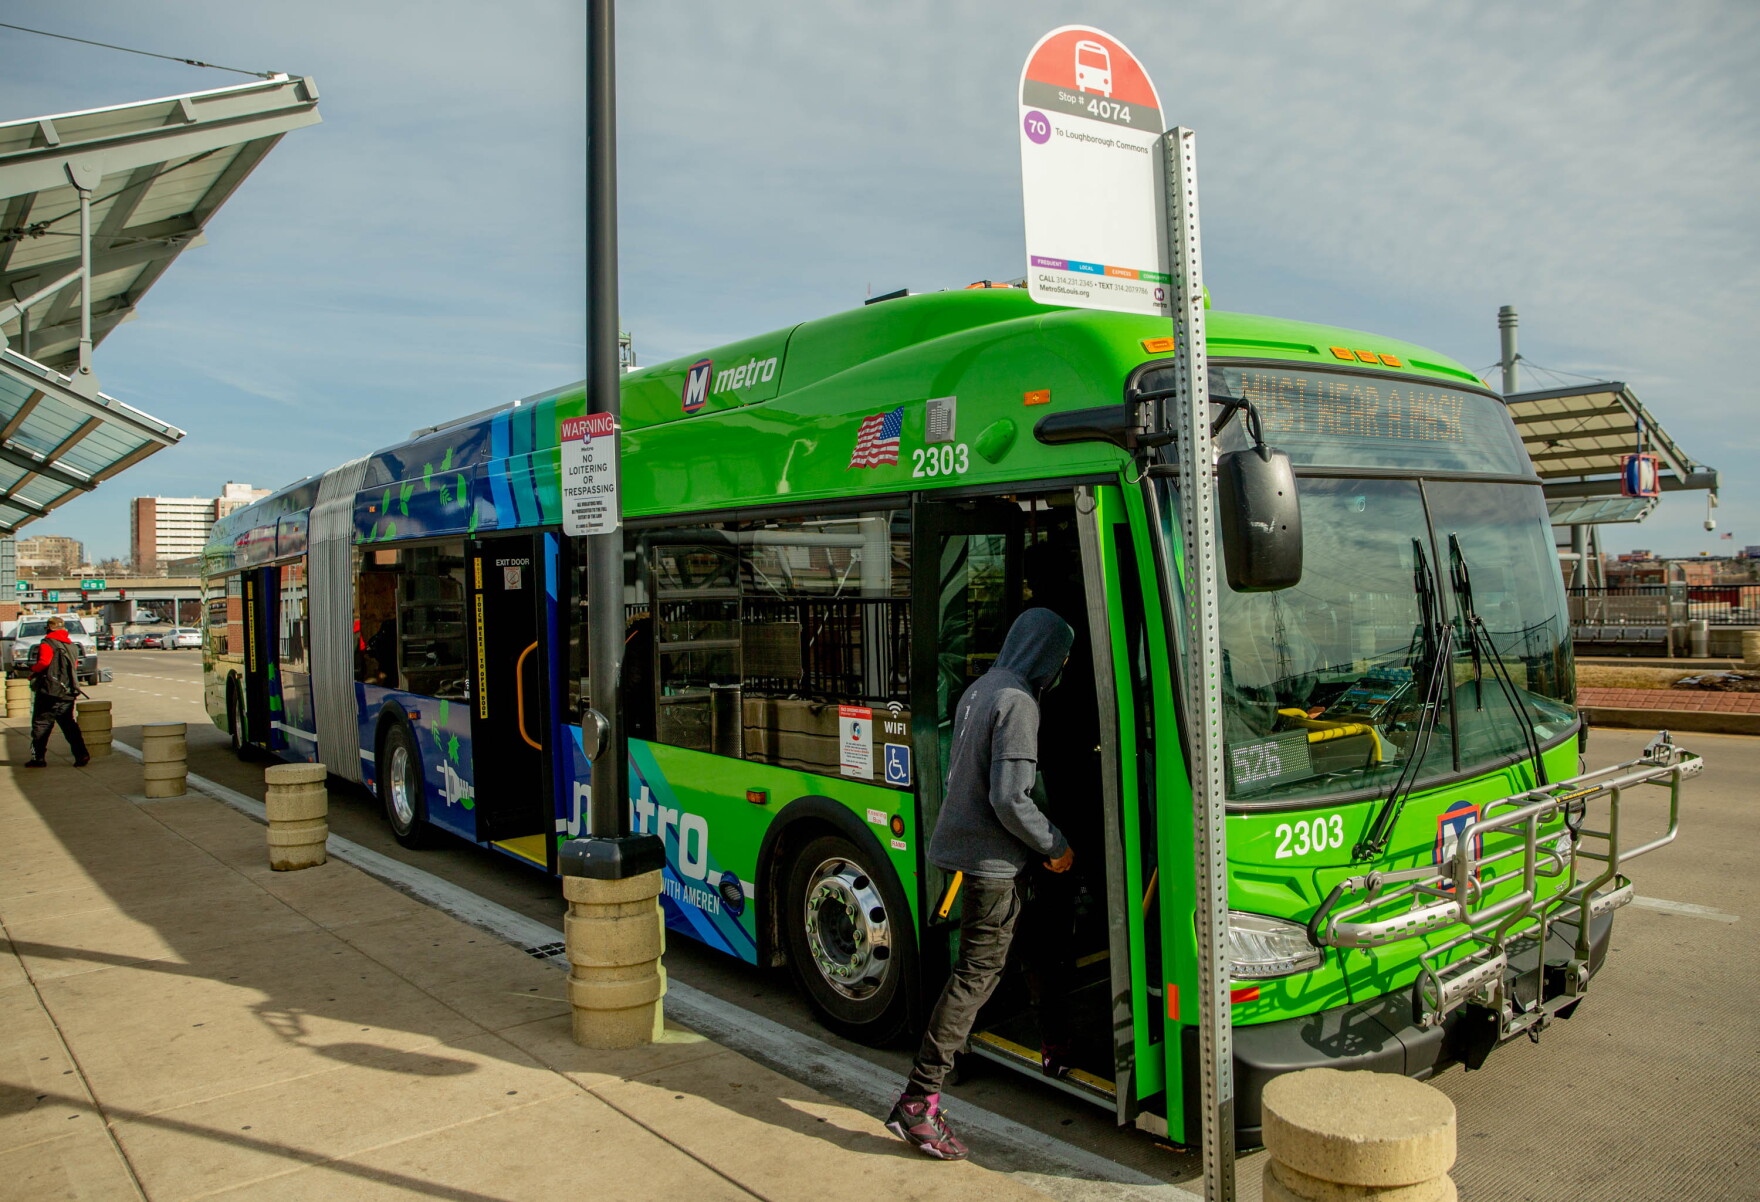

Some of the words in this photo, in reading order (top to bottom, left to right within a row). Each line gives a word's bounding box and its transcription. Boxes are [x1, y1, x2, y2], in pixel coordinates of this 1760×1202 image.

[1058, 91, 1077, 104] Stop
[1078, 96, 1085, 105] #
[1087, 98, 1132, 124] 4074
[1028, 119, 1047, 135] 70
[1055, 127, 1064, 136] To
[1065, 128, 1115, 148] Loughborough
[1116, 140, 1149, 154] Commons
[1037, 258, 1062, 267] FREQUENT
[1079, 264, 1094, 272] LOCAL
[1111, 268, 1132, 277] EXPRESS
[1039, 274, 1056, 283] CALL
[1098, 281, 1113, 291] TEXT
[1039, 284, 1090, 298] MetroStLouis.org
[713, 357, 778, 394] metro
[1388, 389, 1401, 439] A
[562, 417, 613, 437] WARNING
[582, 454, 593, 463] NO
[912, 443, 969, 478] 2303
[569, 463, 608, 475] LOITERING
[583, 476, 594, 484] OR
[564, 484, 614, 497] TRESPASSING
[495, 558, 510, 567] EXIT
[510, 558, 530, 566] DOOR
[884, 720, 907, 736] WIFI
[1232, 741, 1282, 785] 526
[872, 816, 882, 825] Bus
[891, 840, 906, 849] RAMP
[1275, 814, 1344, 860] 2303
[682, 885, 720, 915] AMEREN
